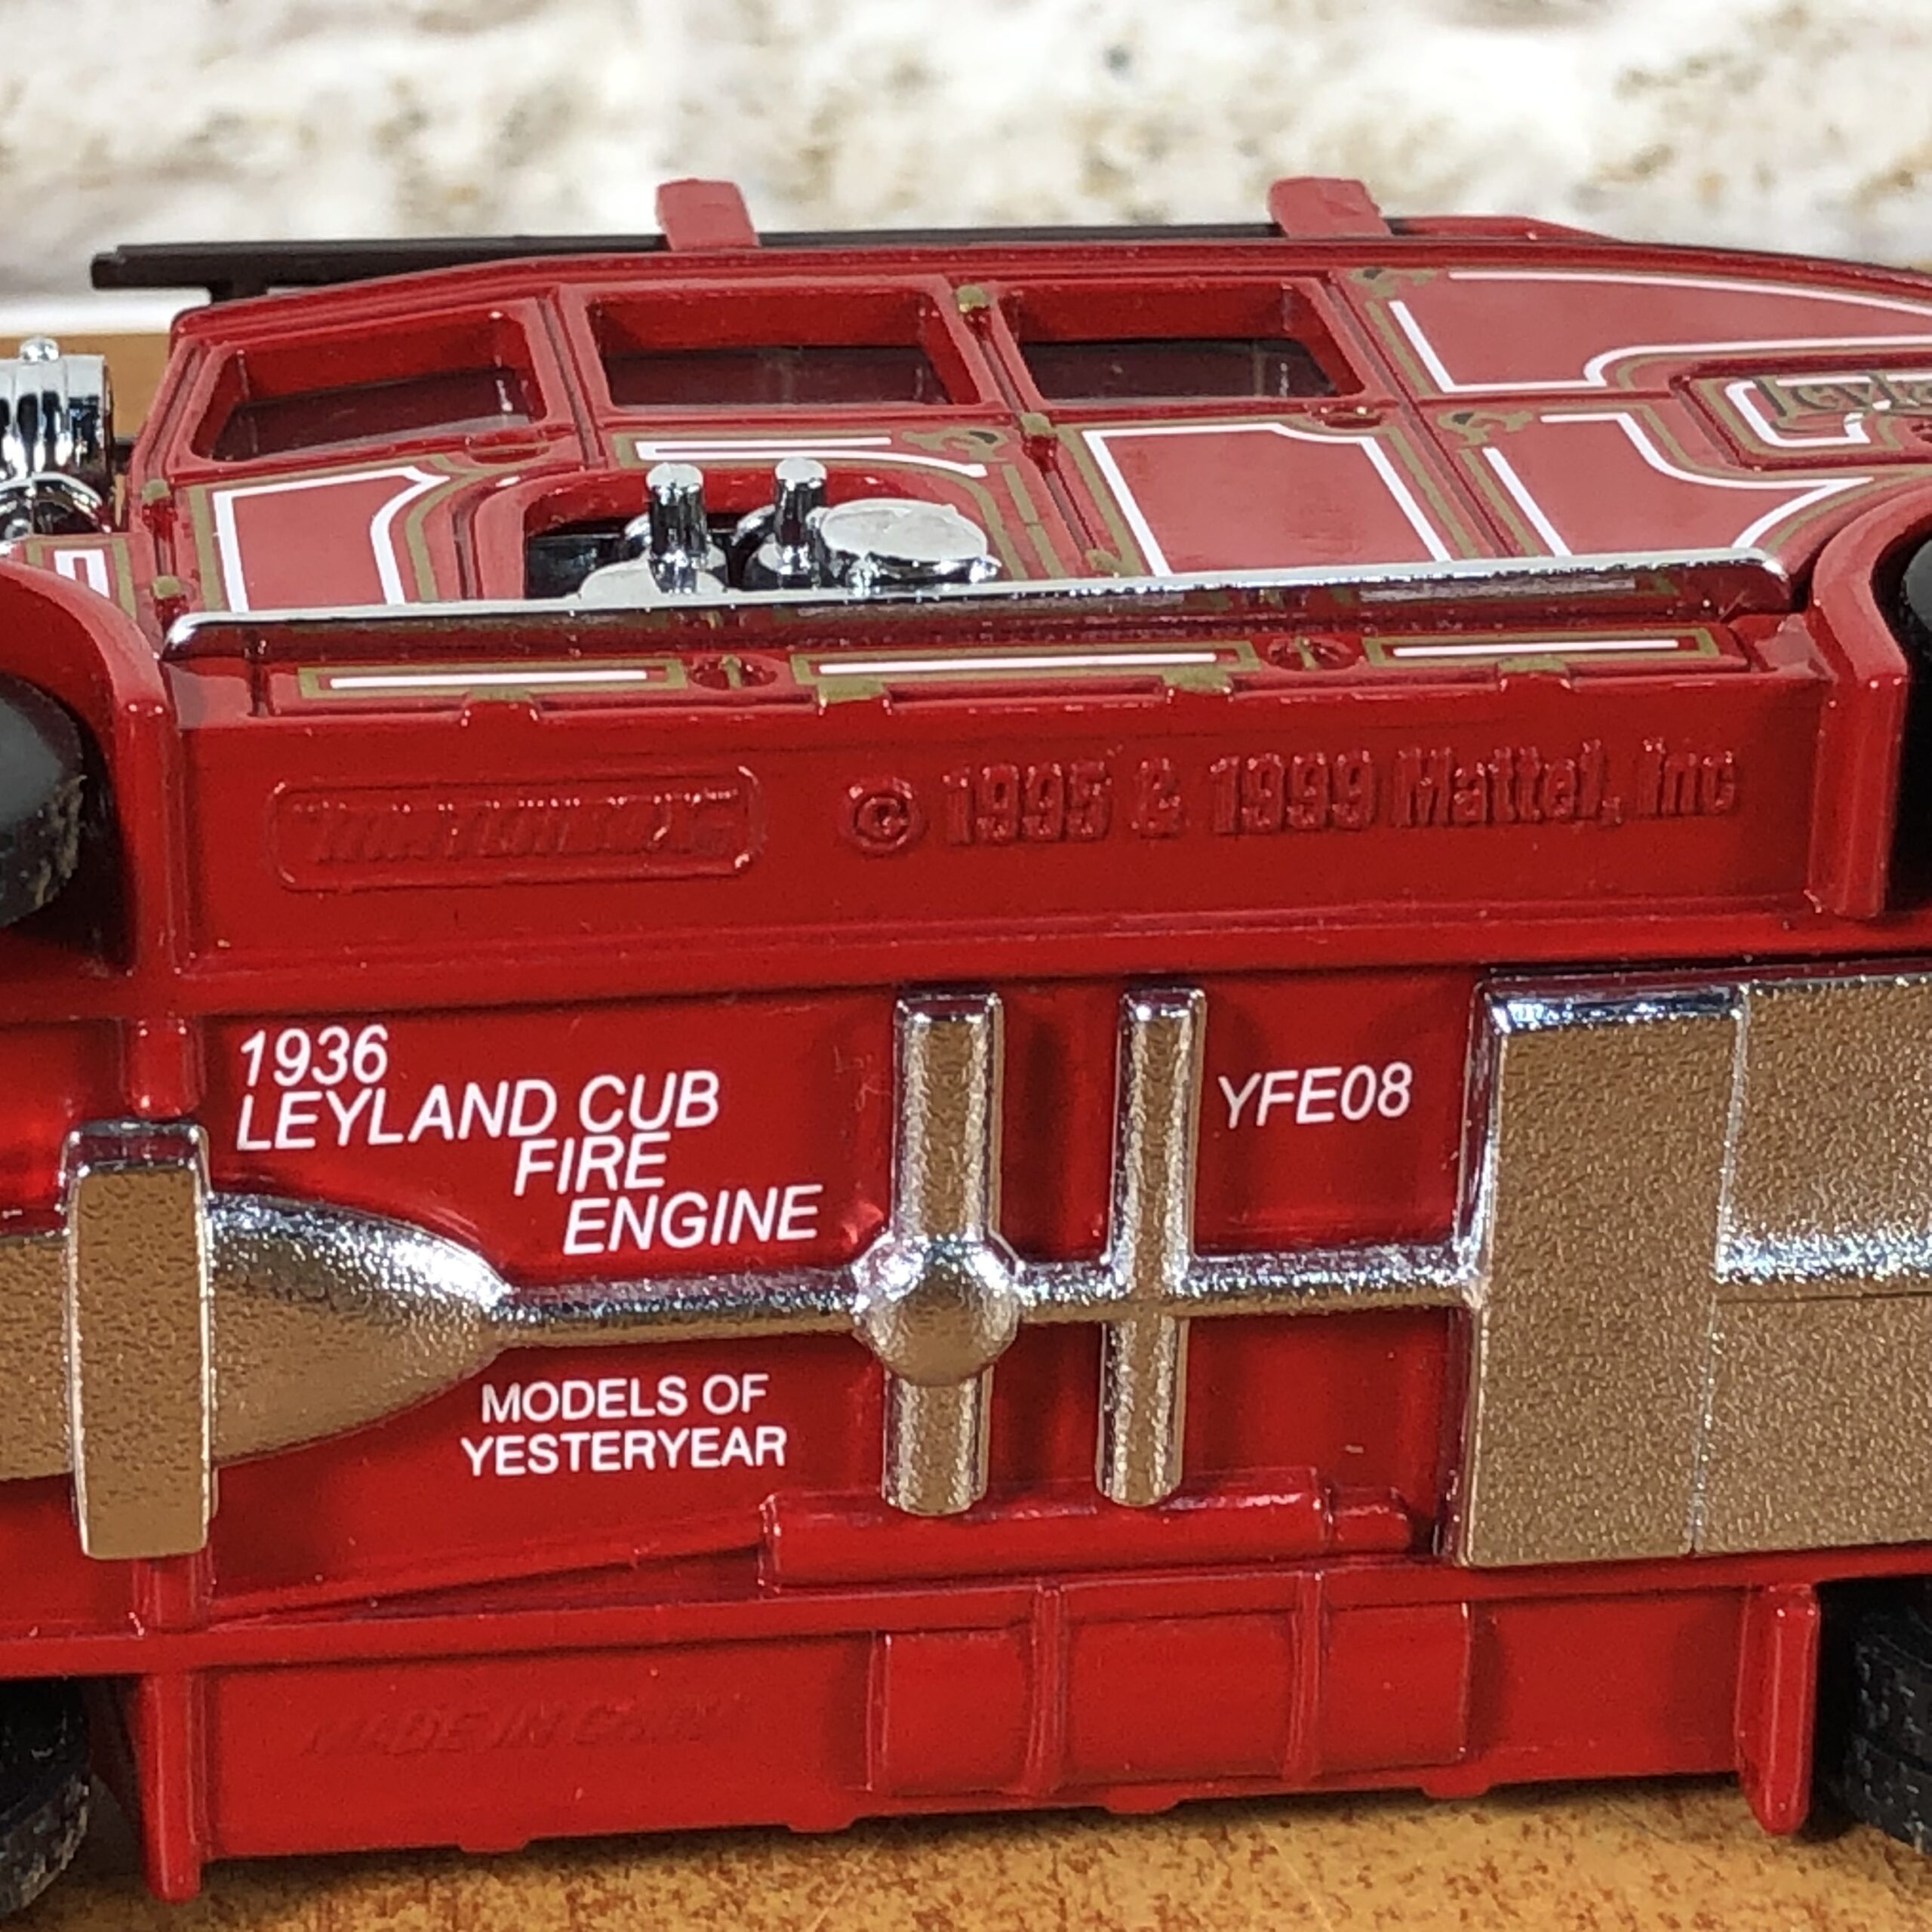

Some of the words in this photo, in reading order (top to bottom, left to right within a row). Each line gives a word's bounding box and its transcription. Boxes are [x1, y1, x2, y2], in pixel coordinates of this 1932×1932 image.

[940, 757, 1114, 845] 1995
[1209, 751, 1375, 836] 1999
[240, 1023, 389, 1088] 1936
[236, 1079, 558, 1151] LEYLAND
[578, 1069, 720, 1134] CUB
[1217, 1061, 1413, 1129] YFE08
[513, 1131, 672, 1196] FIRE
[562, 1183, 823, 1256] ENGINE
[481, 1375, 688, 1423] MODELS
[702, 1374, 769, 1415] OF
[460, 1425, 788, 1477] YESTERYEAR
